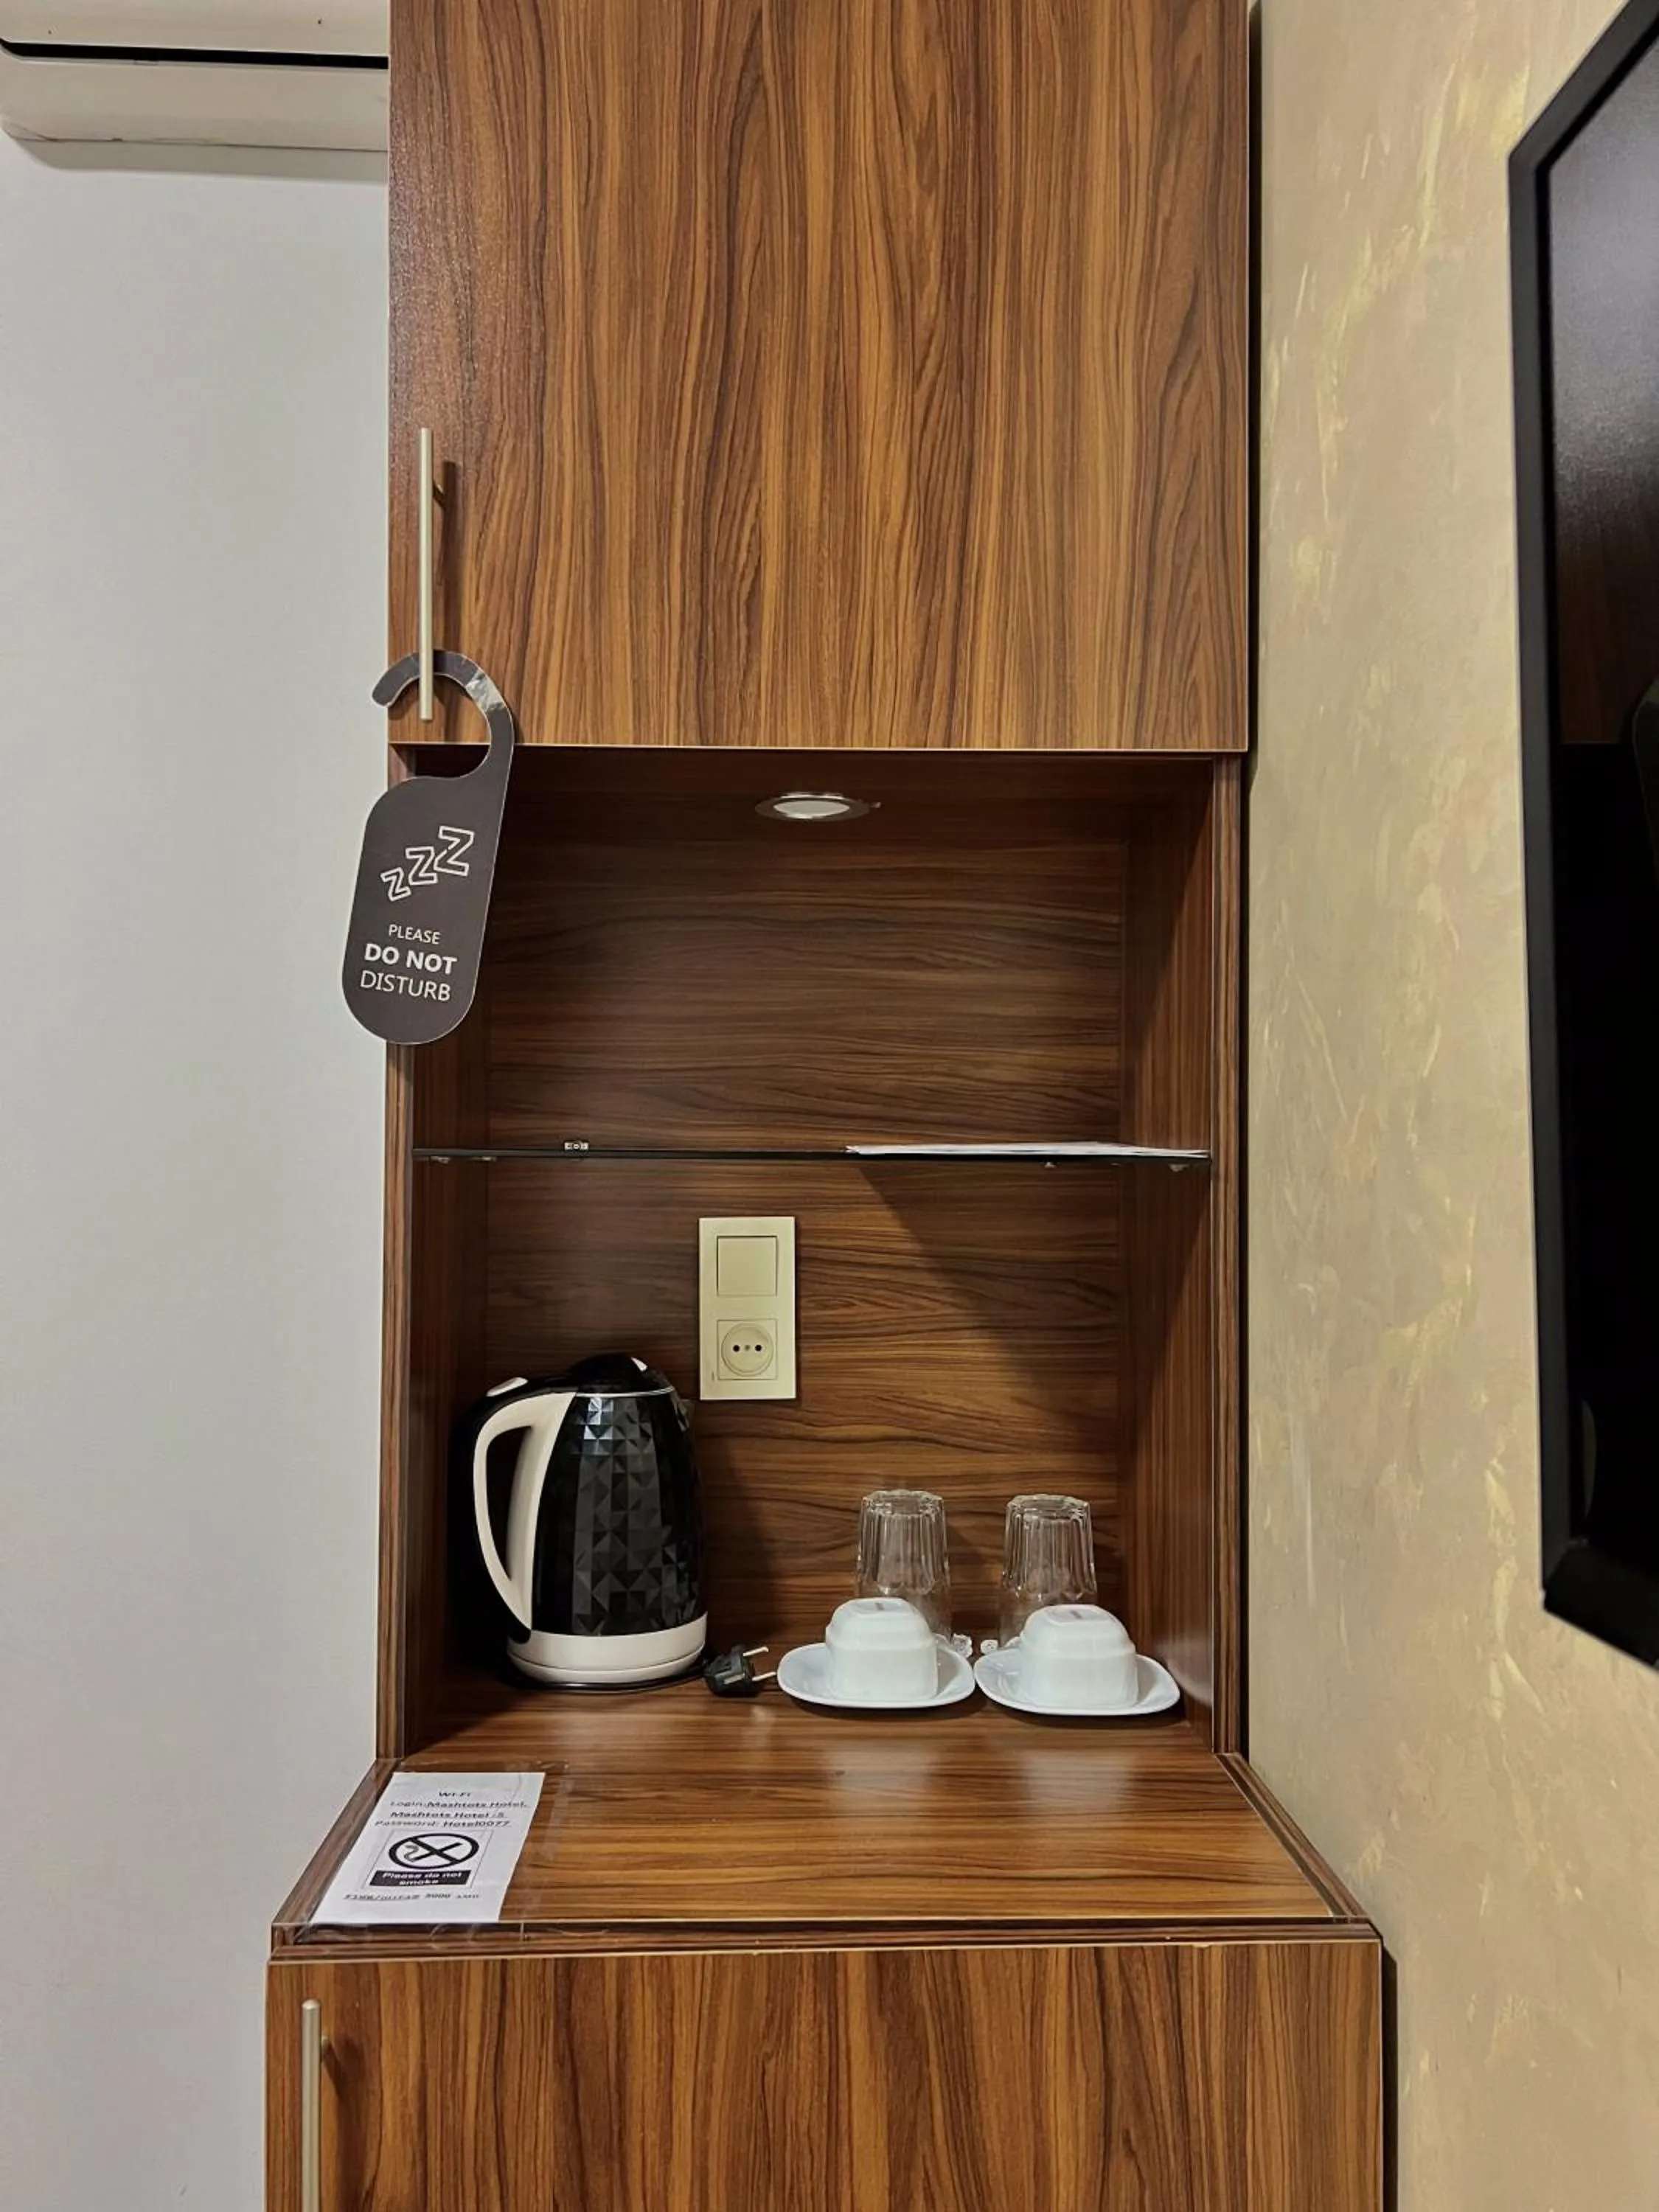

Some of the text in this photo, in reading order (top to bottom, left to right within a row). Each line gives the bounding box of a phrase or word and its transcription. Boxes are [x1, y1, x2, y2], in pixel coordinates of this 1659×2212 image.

[389, 924, 441, 944] PLEASE
[364, 943, 457, 975] DO NOT
[360, 970, 451, 1001] DISTURB
